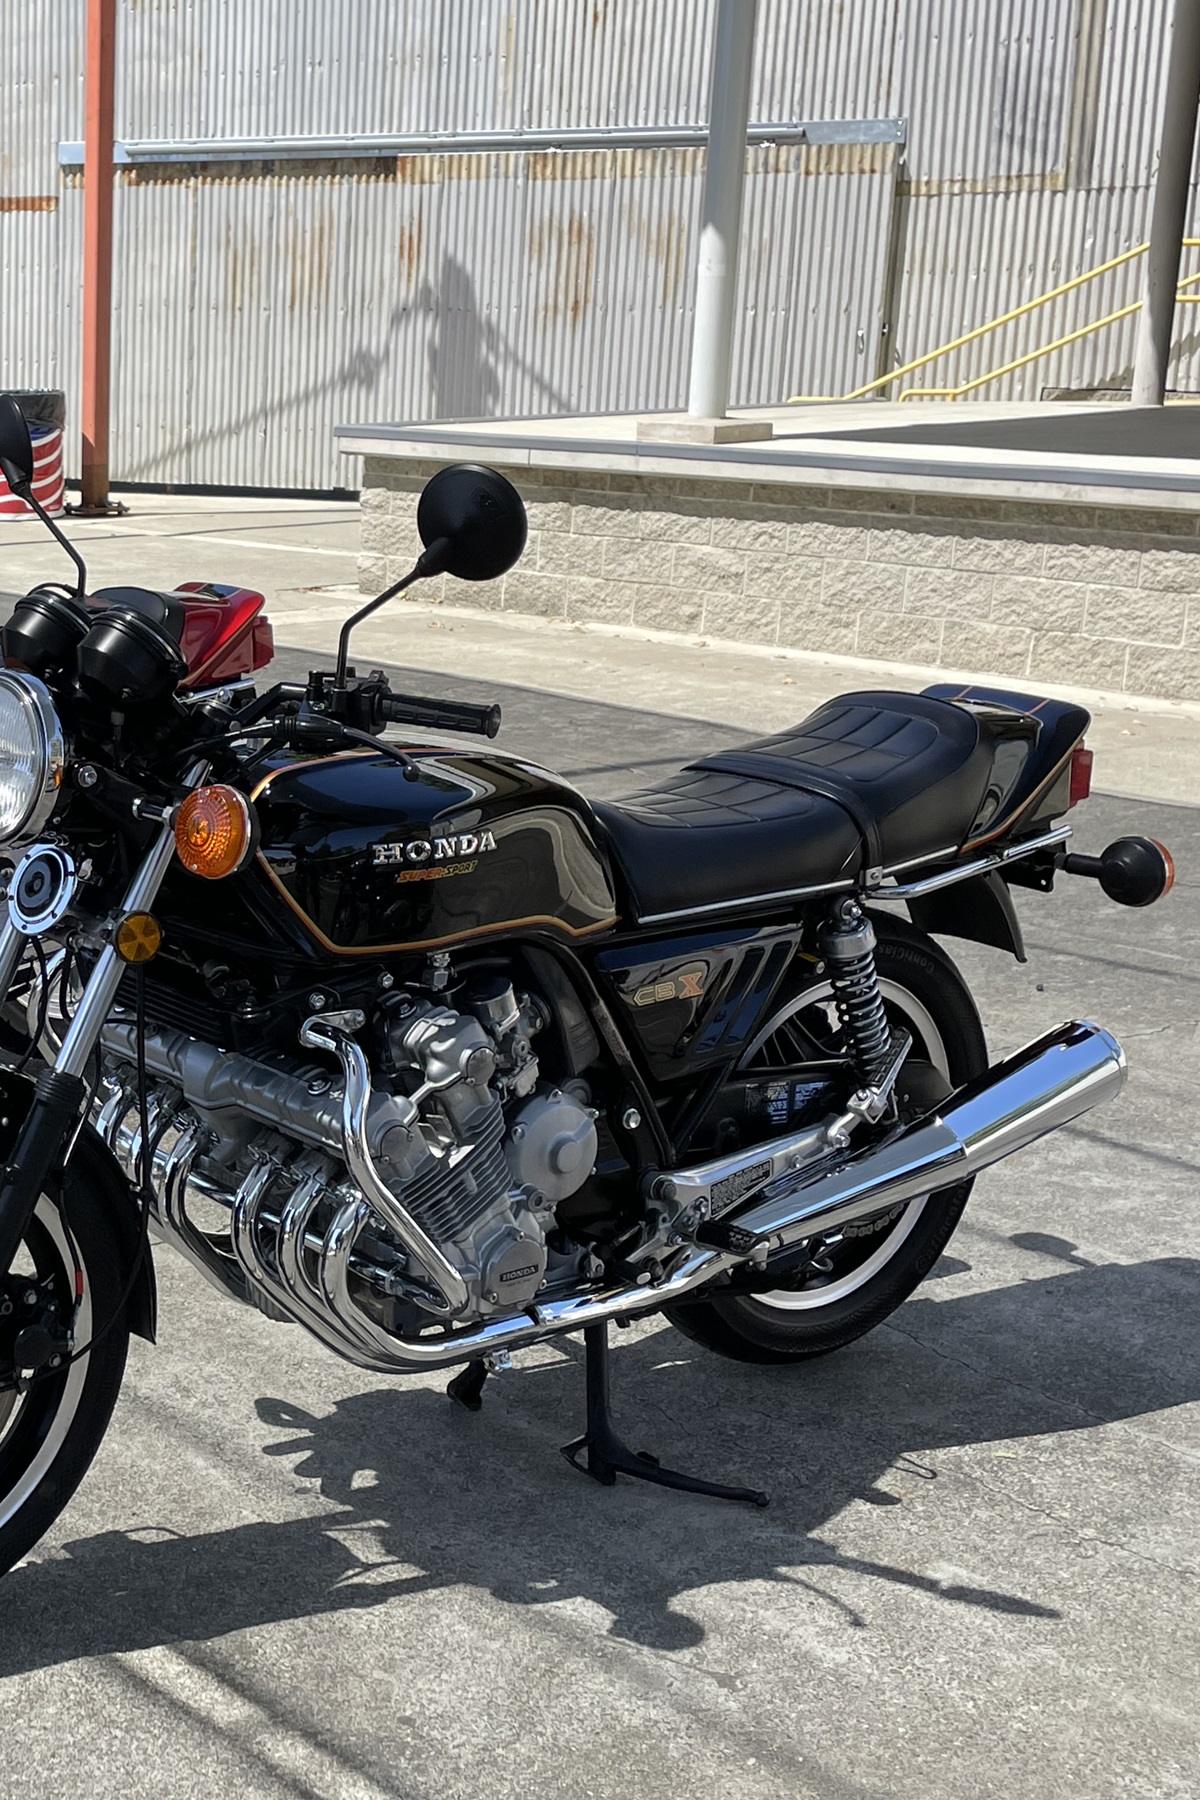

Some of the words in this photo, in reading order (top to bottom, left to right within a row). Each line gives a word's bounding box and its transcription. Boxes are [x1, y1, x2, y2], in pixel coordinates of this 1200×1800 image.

[371, 831, 498, 866] HONDA
[398, 867, 444, 882] SUPER
[444, 860, 478, 876] SPORT
[874, 944, 934, 975] ContiClas
[633, 971, 704, 1007] CBX
[502, 1266, 536, 1281] HONDA
